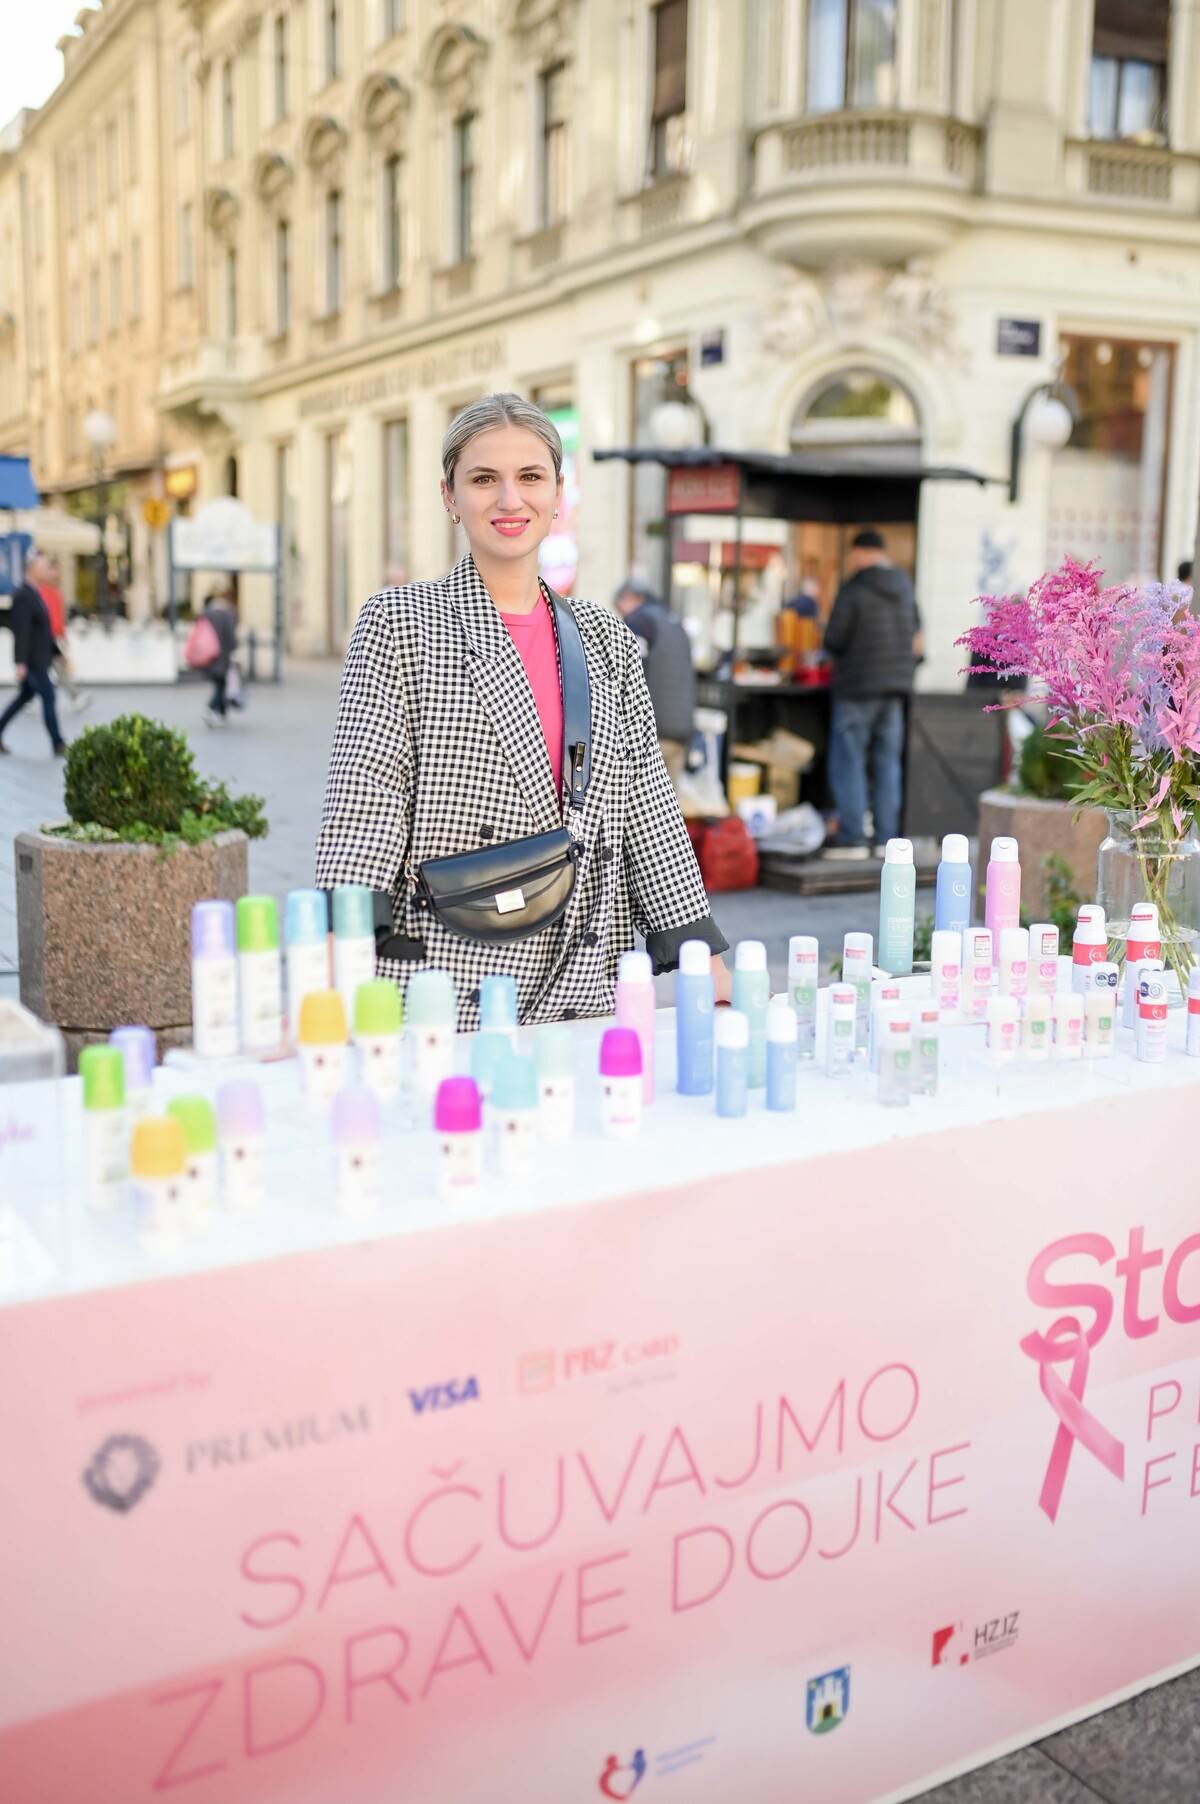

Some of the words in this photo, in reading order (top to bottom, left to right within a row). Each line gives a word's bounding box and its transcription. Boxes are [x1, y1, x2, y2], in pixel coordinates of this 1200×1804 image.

[407, 1376, 480, 1415] VISA
[184, 1403, 371, 1475] PREMIUM
[239, 1362, 920, 1630] SAČUVAJMO
[149, 1550, 631, 1793] ZDRAVE
[671, 1442, 972, 1614] DOJKE
[974, 1610, 1020, 1647] HZJZ
